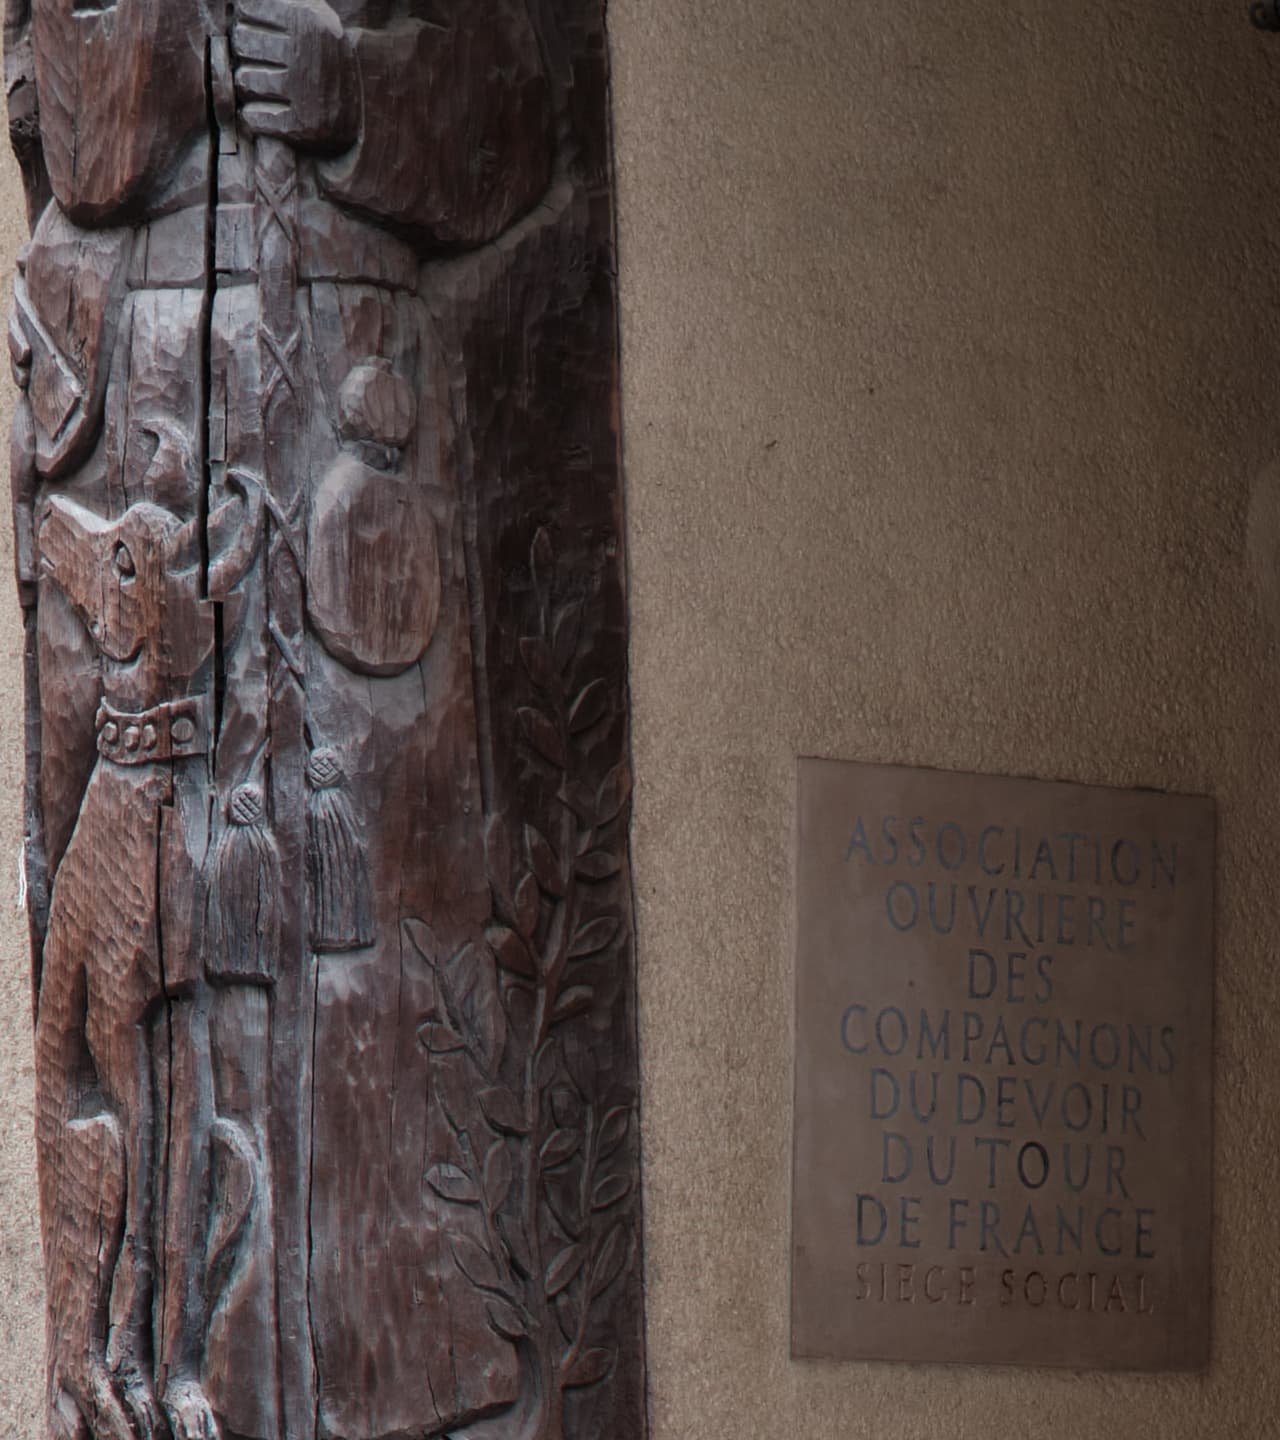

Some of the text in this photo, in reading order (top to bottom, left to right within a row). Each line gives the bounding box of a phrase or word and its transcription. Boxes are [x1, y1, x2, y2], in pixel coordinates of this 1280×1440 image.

[844, 814, 1179, 890] ASSOCIATION
[885, 879, 1138, 952] OUVRIERE
[967, 947, 1055, 1004] DES
[839, 1003, 1177, 1075] COMPAGNONS
[868, 1067, 1147, 1141] DU DEVOIR
[880, 1130, 1130, 1201] DU TOUR
[855, 1192, 1156, 1259] DE FRANCE
[855, 1262, 1153, 1313] SIEGE SOCIAL
